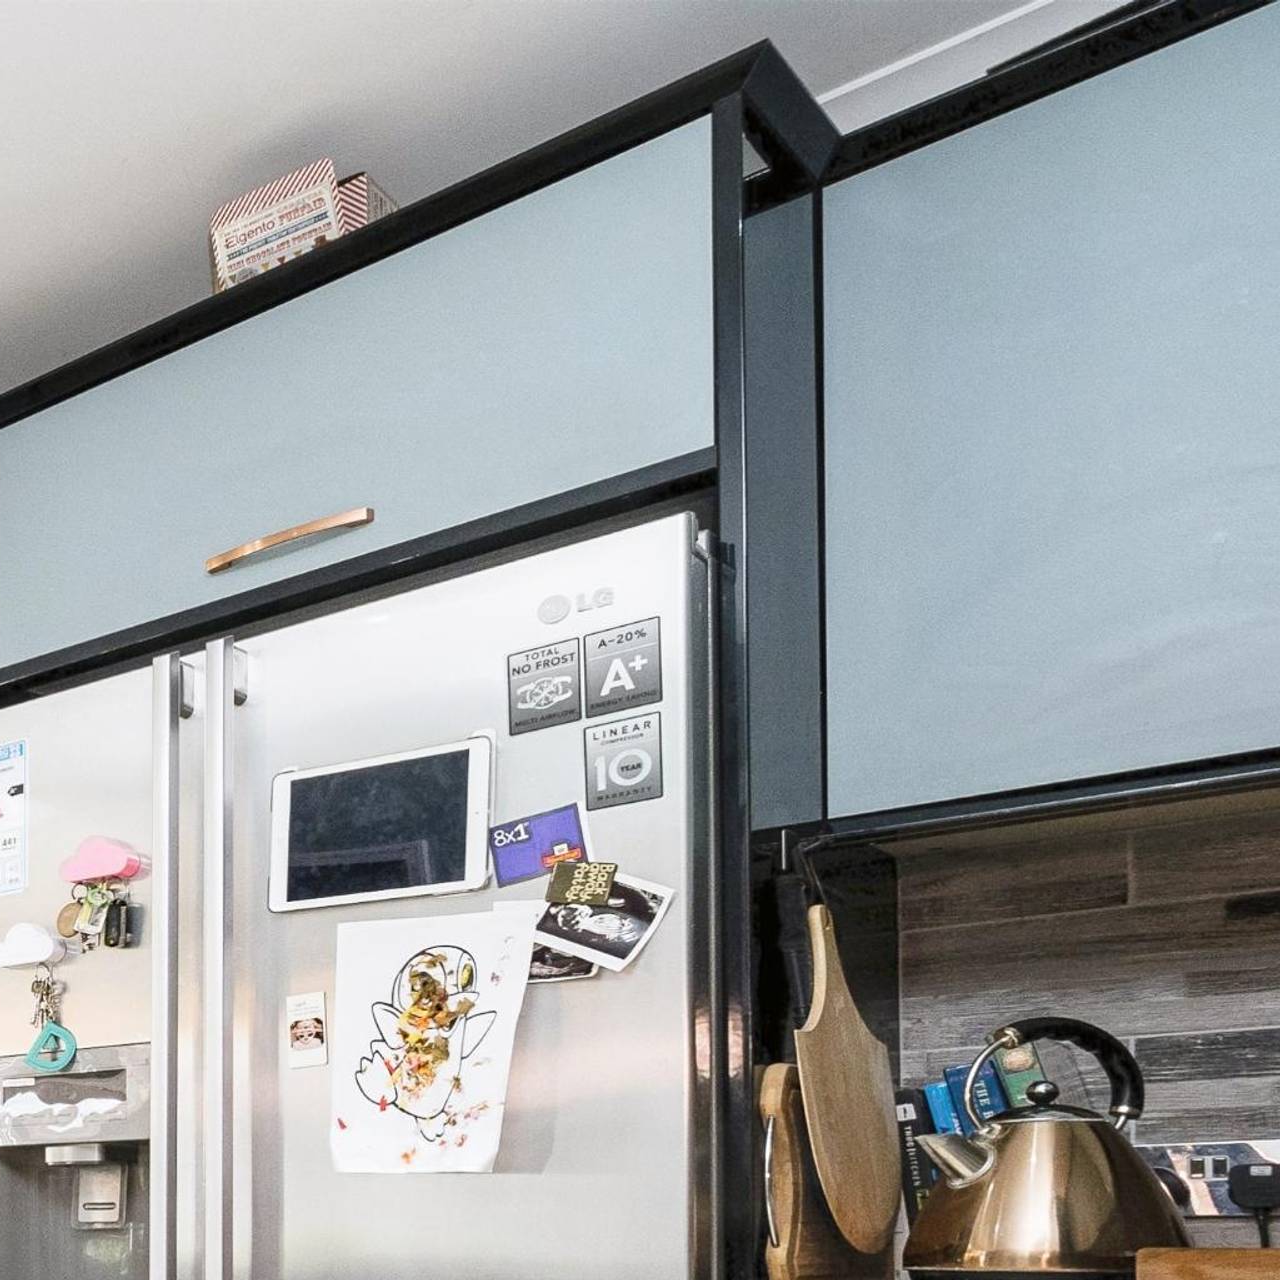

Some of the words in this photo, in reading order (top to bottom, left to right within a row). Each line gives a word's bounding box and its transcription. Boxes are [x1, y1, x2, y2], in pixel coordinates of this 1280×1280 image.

[224, 217, 275, 249] Elgento
[577, 587, 614, 612] LG
[598, 628, 647, 648] A-20%
[512, 664, 531, 676] NO
[536, 652, 576, 670] FROST
[525, 646, 559, 661] TOTAL
[600, 655, 648, 696] A+
[593, 720, 651, 740] LINEAR
[594, 748, 652, 791] 10
[621, 762, 642, 772] YEAR
[597, 786, 651, 801] WARRANTY
[594, 864, 616, 895] Back
[974, 1080, 991, 1107] THE
